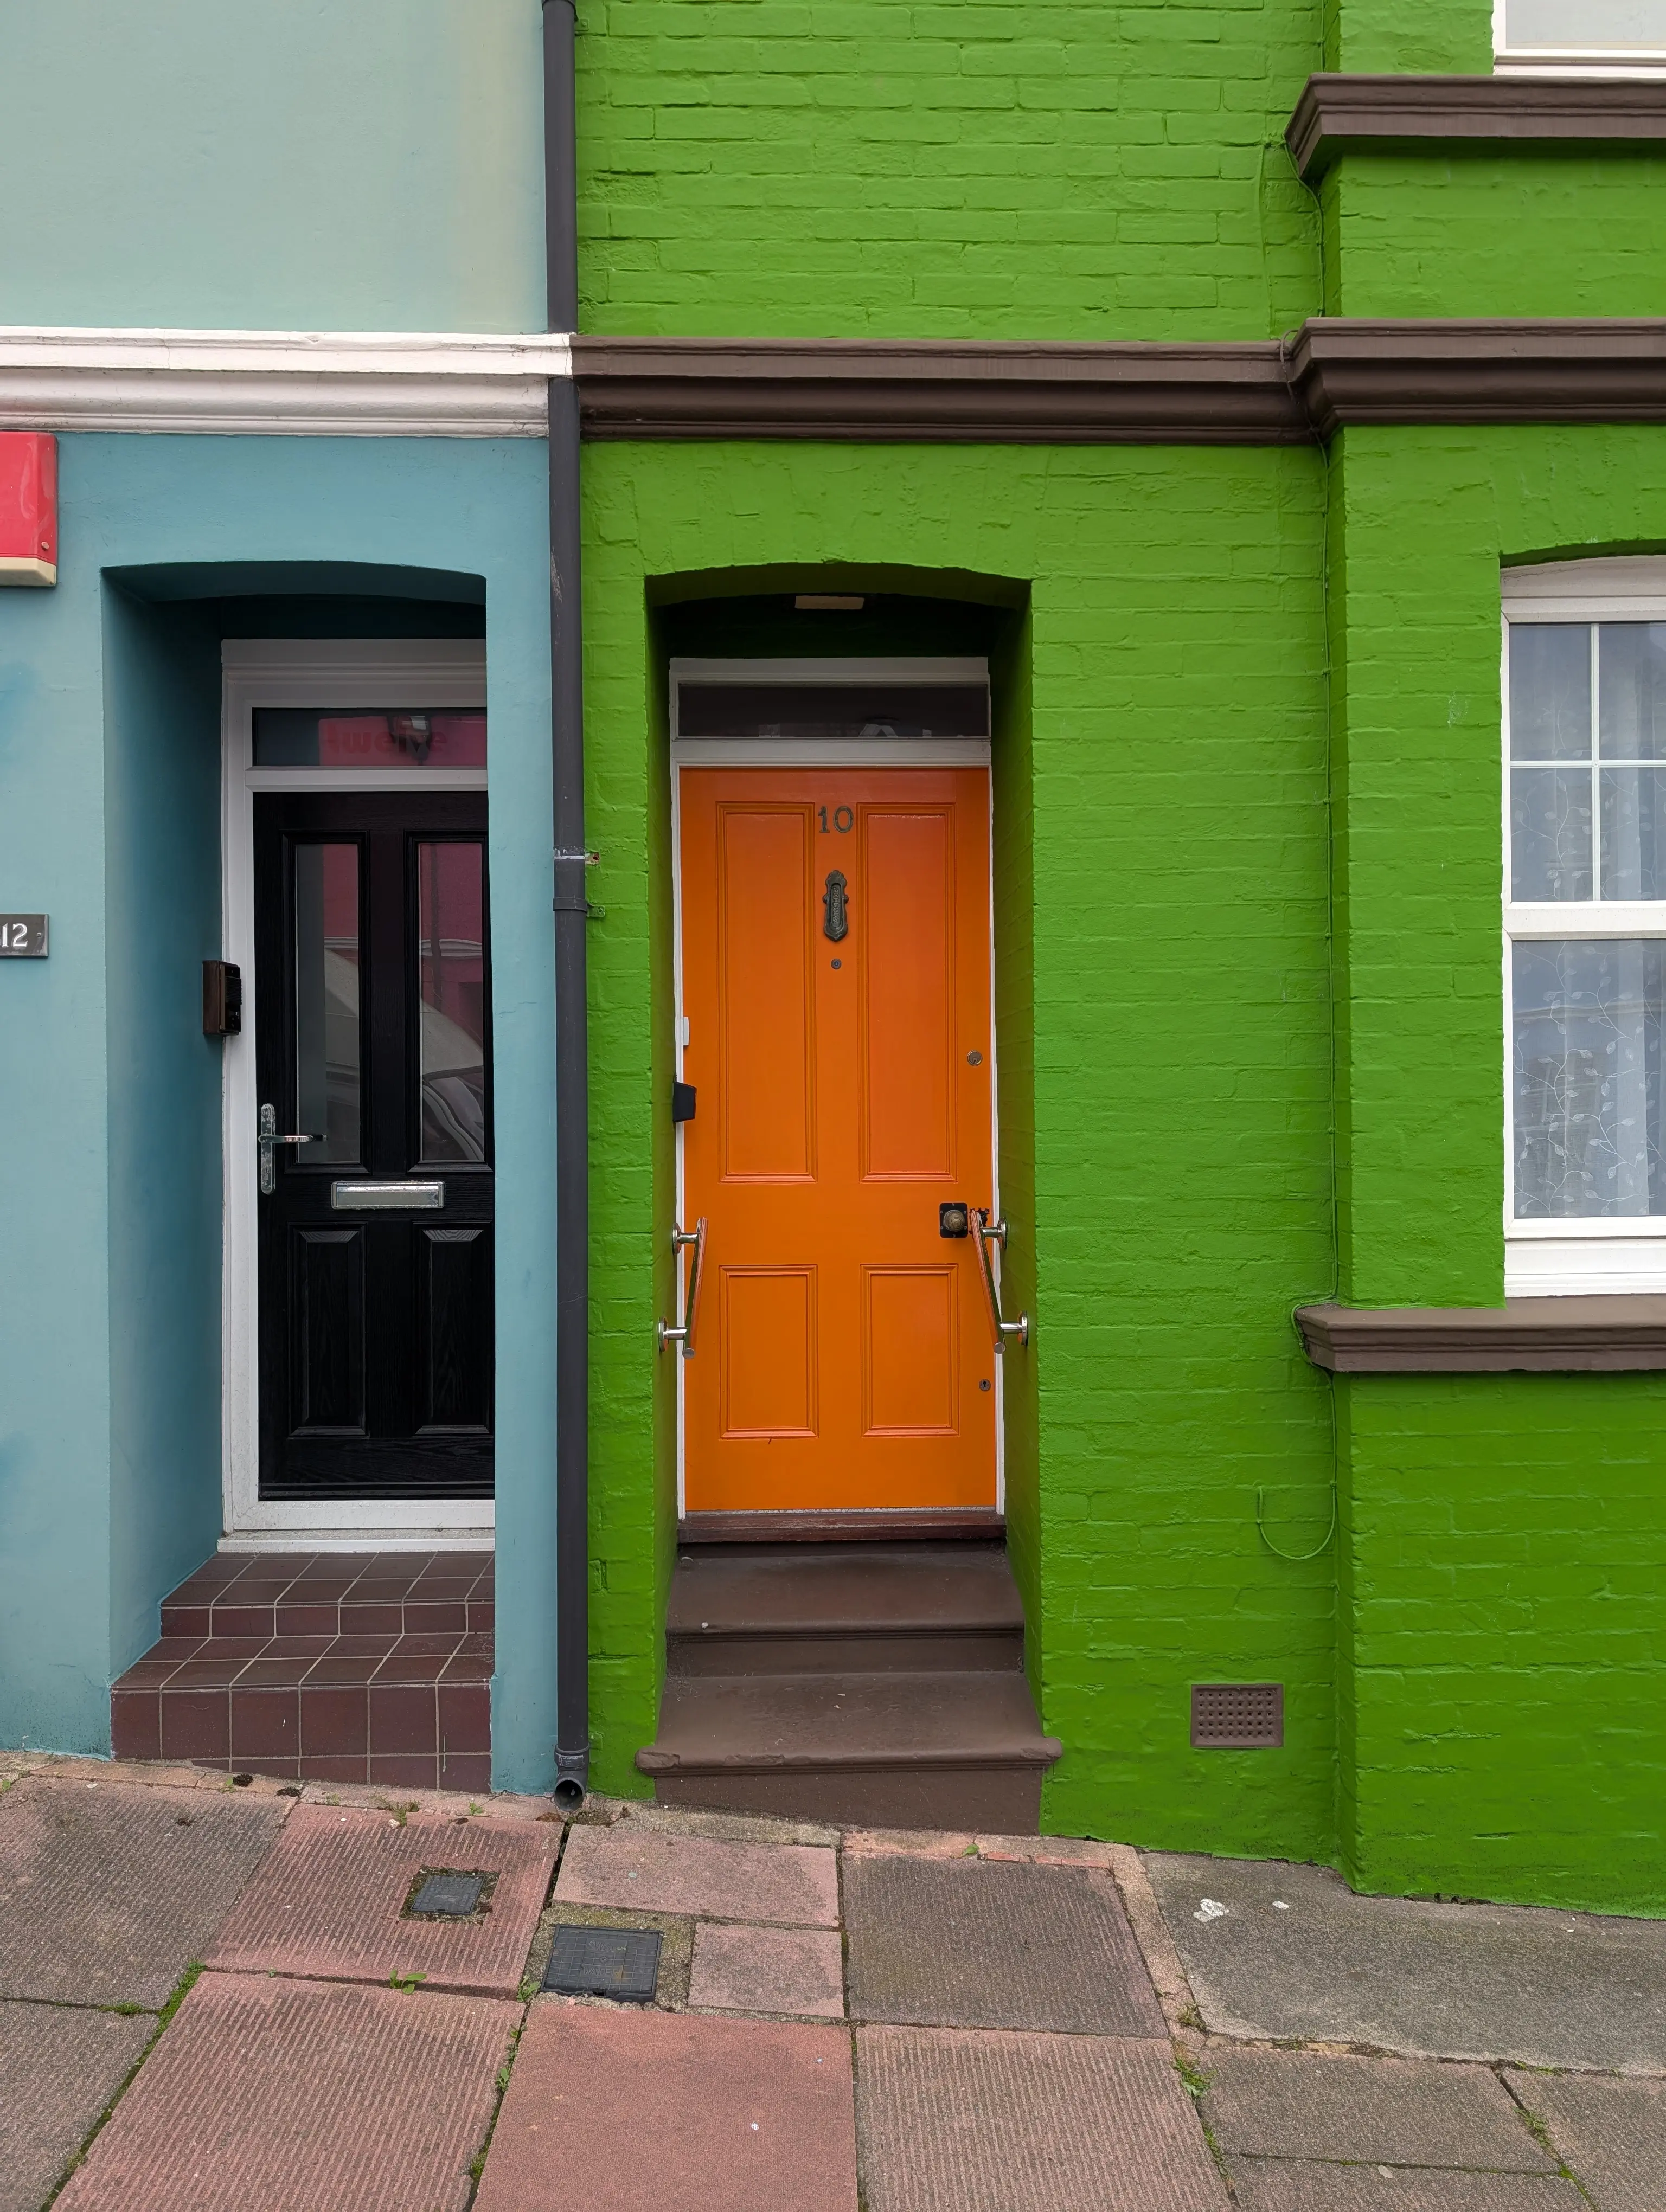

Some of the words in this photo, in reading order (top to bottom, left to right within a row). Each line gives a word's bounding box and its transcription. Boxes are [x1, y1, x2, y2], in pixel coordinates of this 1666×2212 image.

[325, 721, 448, 754] twelve
[818, 806, 854, 833] 10
[1, 922, 28, 947] 12
[584, 1966, 620, 1978] WATER
